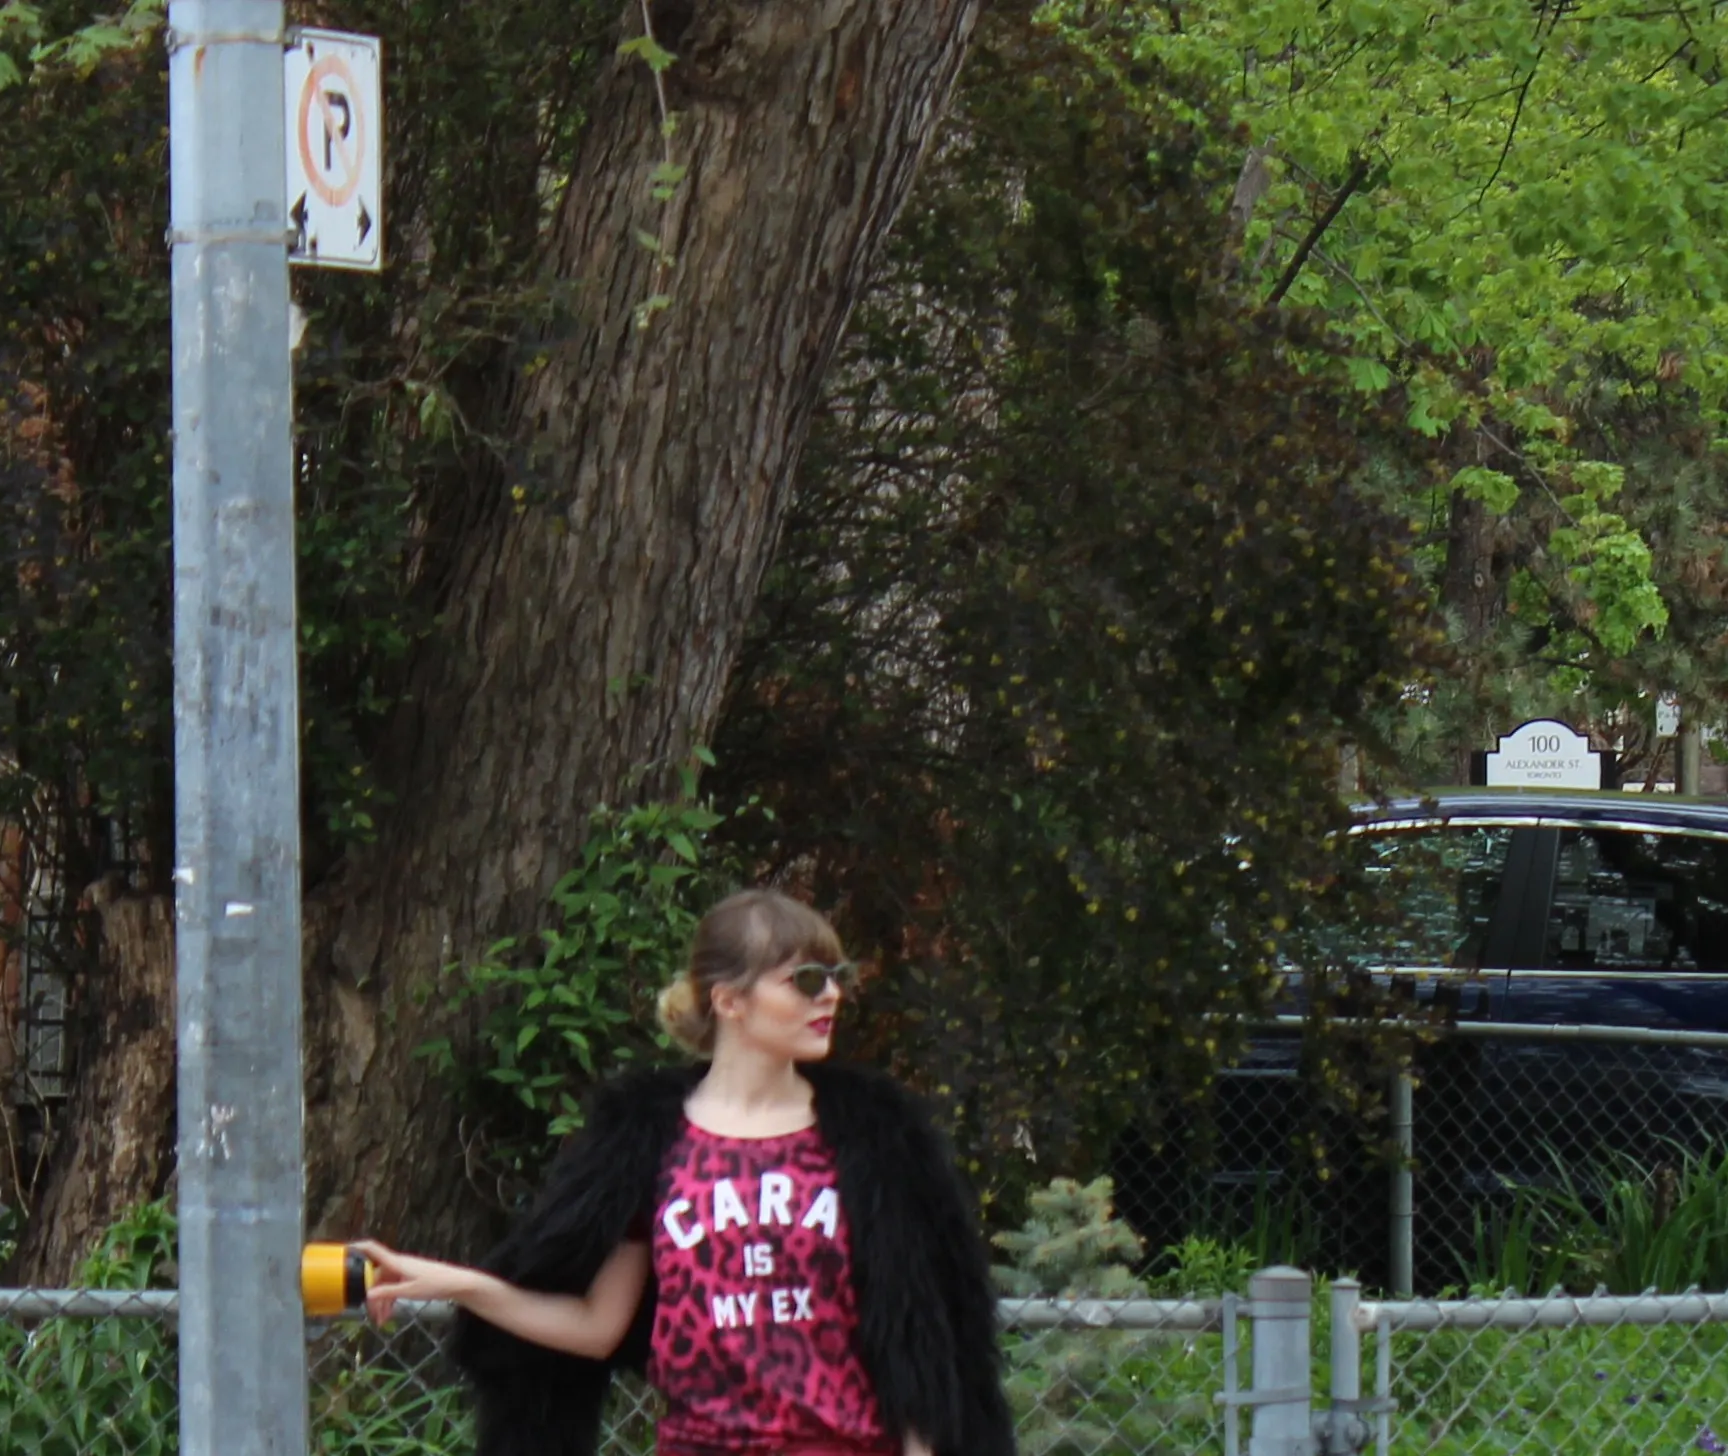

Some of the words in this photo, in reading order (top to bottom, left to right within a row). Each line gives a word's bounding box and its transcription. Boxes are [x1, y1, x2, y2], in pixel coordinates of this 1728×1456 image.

[1528, 735, 1560, 753] 100
[1505, 759, 1565, 770] ALEXANDER
[663, 1172, 839, 1249] CARA
[743, 1244, 773, 1277] IS
[712, 1292, 758, 1329] MY
[772, 1287, 814, 1323] EX
